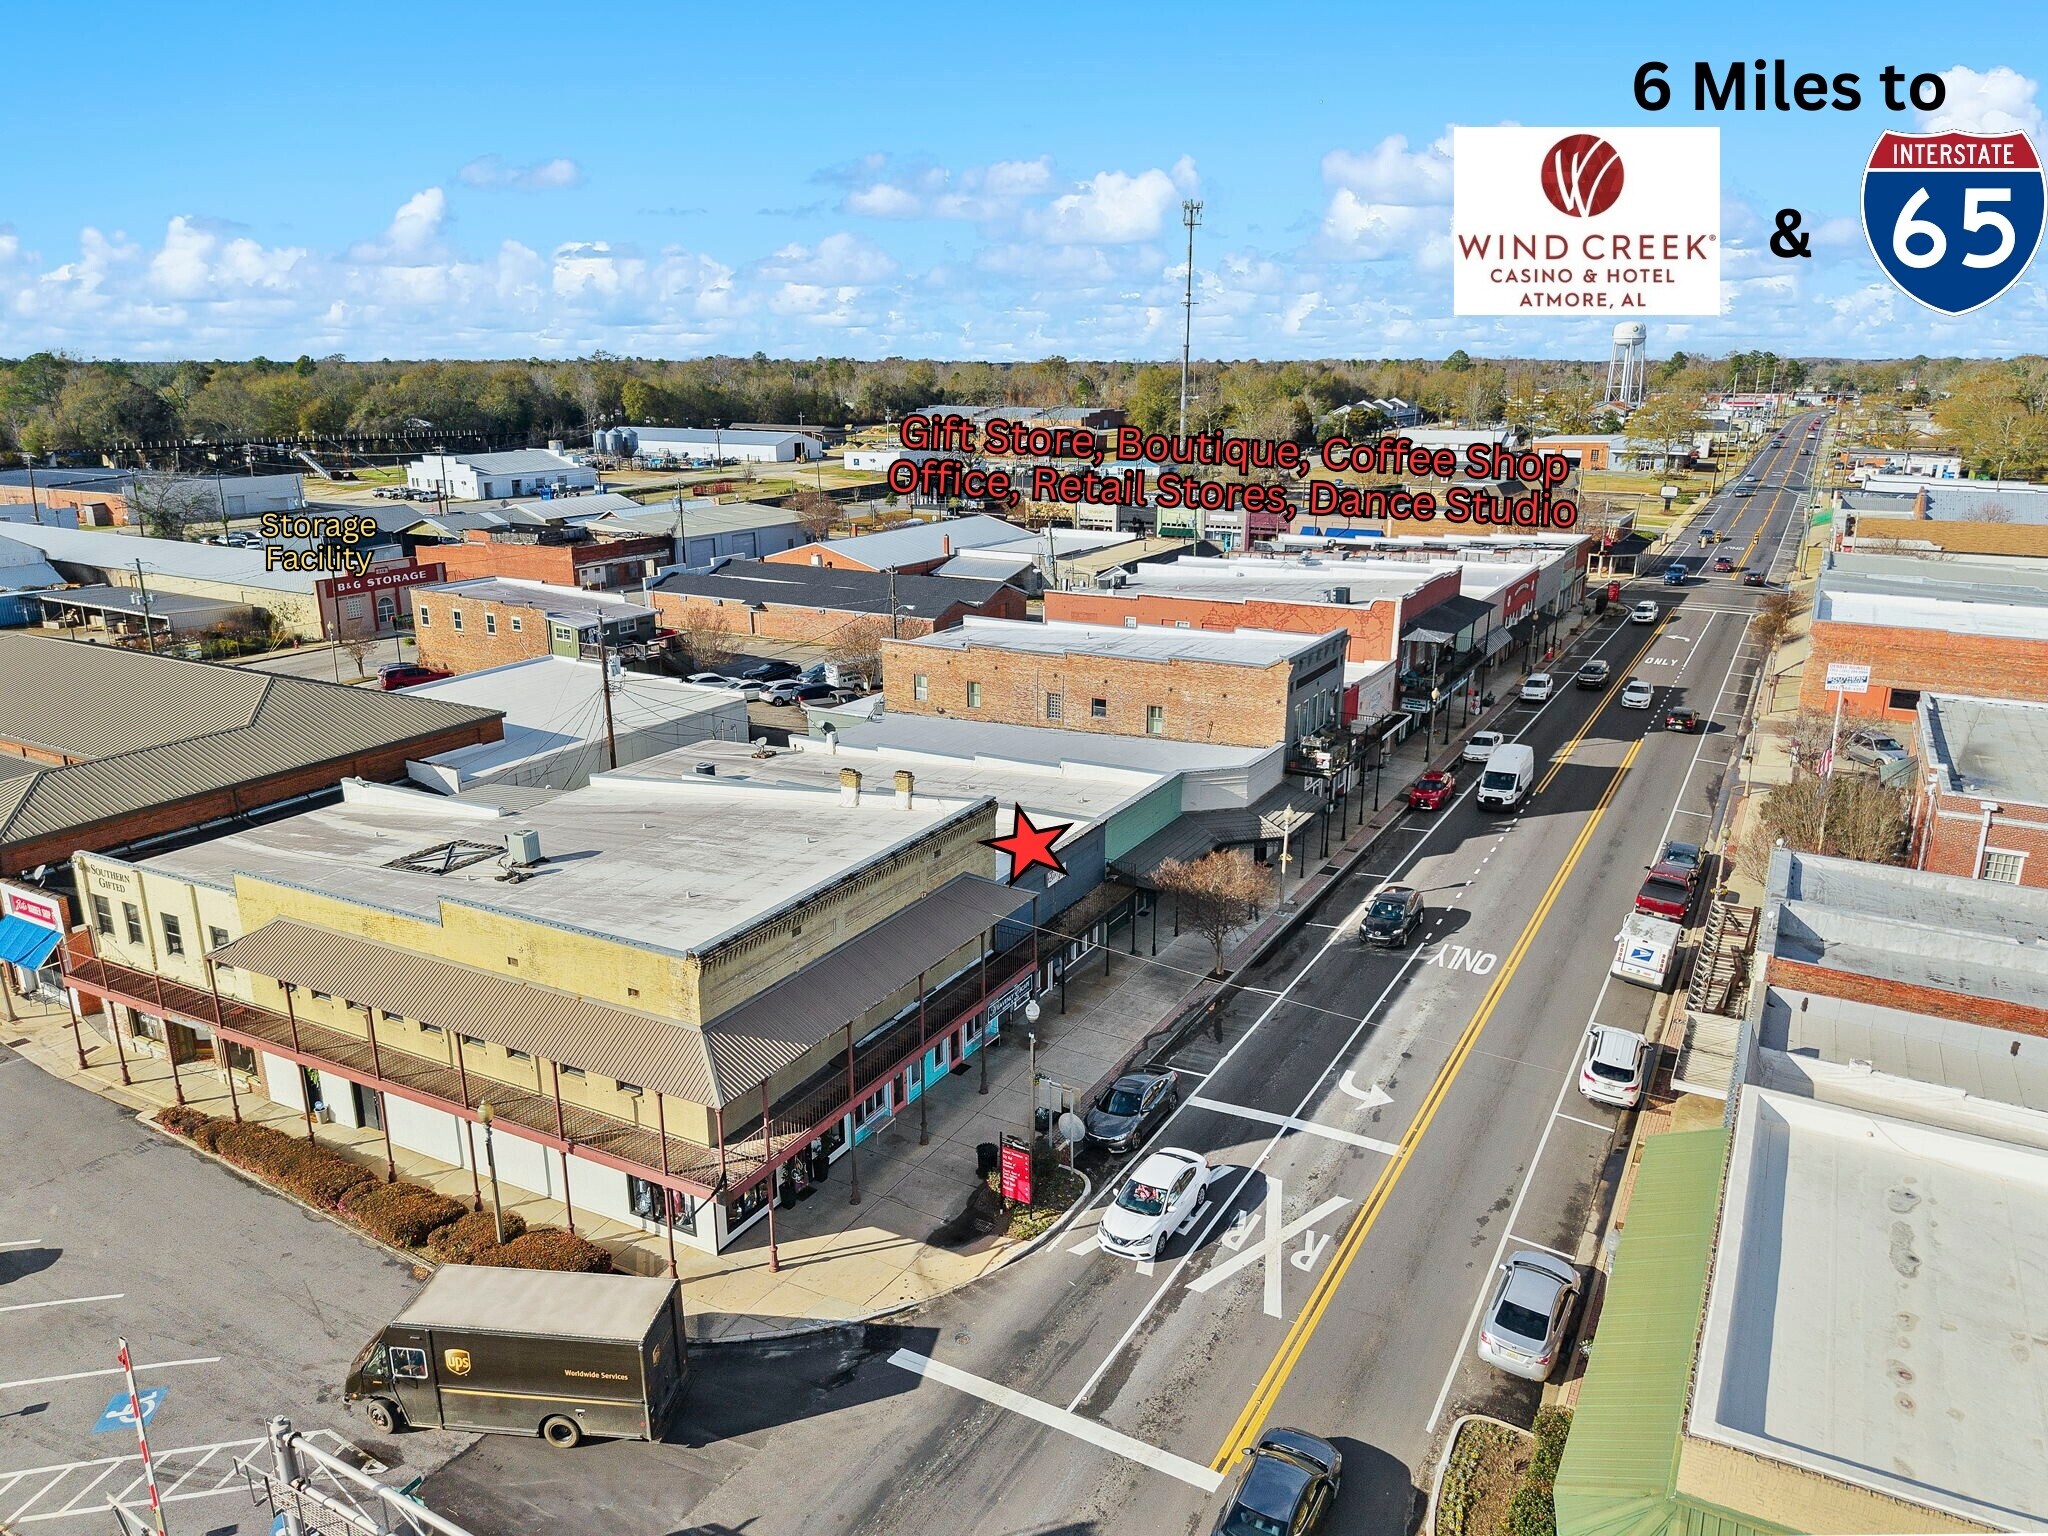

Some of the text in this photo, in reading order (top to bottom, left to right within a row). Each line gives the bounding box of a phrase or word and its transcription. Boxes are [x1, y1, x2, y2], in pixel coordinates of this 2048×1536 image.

[337, 580, 362, 592] B&G
[366, 571, 428, 587] STORAGE
[1644, 657, 1678, 666] ONLY
[90, 864, 130, 883] SOUTHERN
[98, 878, 126, 893] GIFTED
[1426, 943, 1498, 975] ONLY
[1221, 1209, 1262, 1251] R
[1291, 1230, 1332, 1273] R
[447, 1354, 470, 1371] ups
[564, 1369, 629, 1381] Worldwide Services
